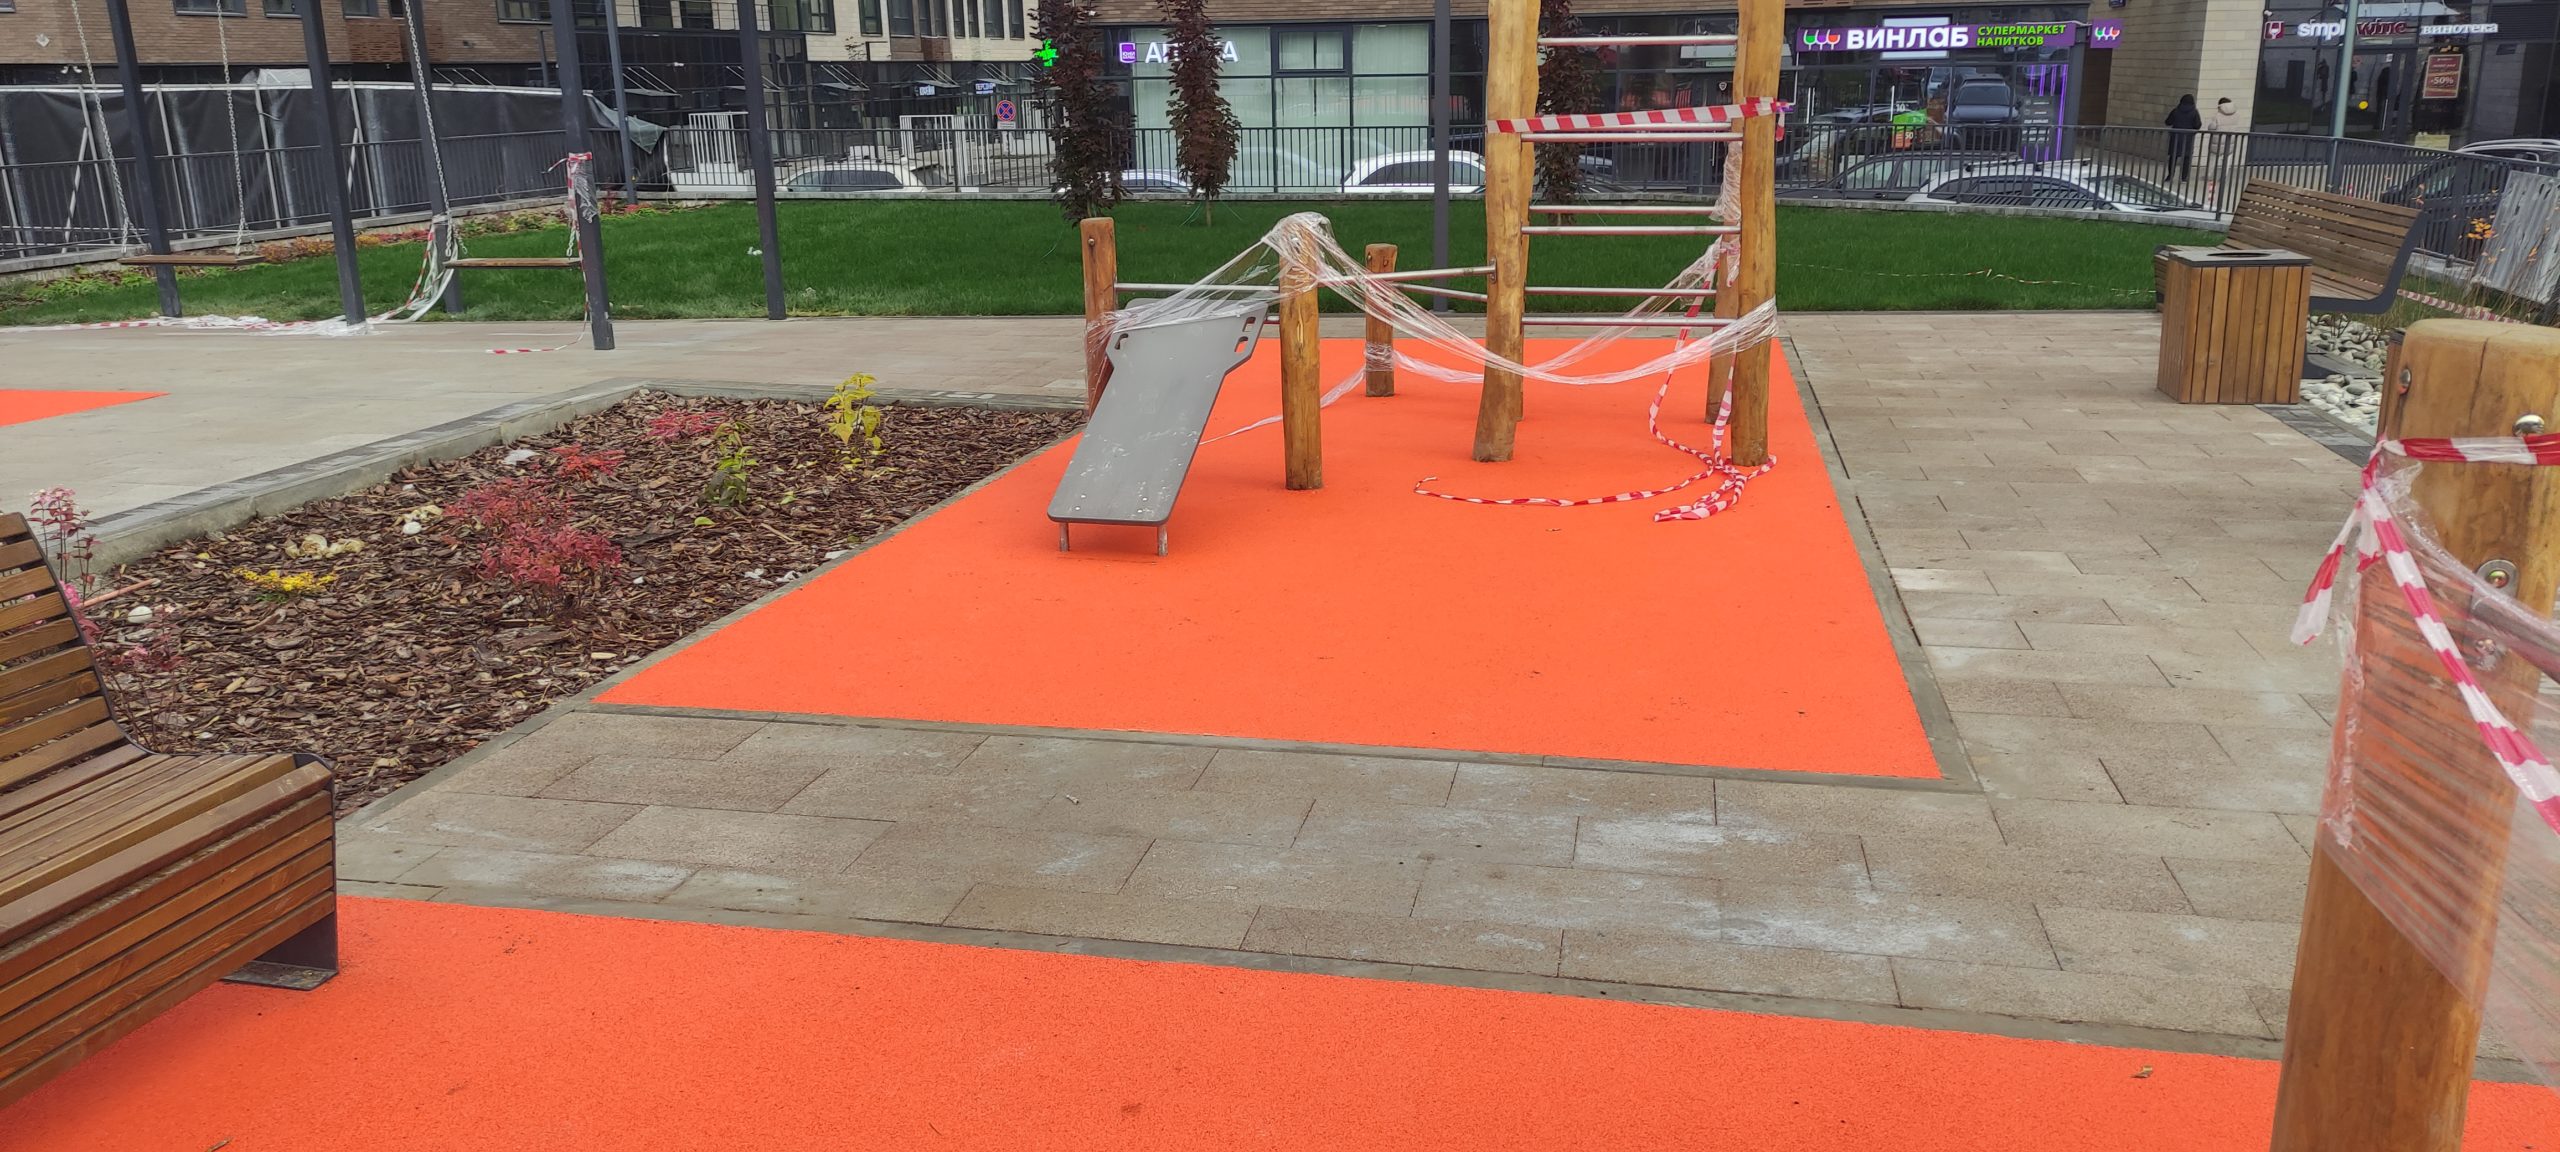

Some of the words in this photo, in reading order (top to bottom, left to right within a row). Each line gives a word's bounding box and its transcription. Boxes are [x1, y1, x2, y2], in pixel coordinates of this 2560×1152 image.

[1977, 25, 2066, 35] СУПЕРМАРКЕТ
[2420, 23, 2498, 35] винотека
[1976, 36, 2044, 46] НАПИТКОВ
